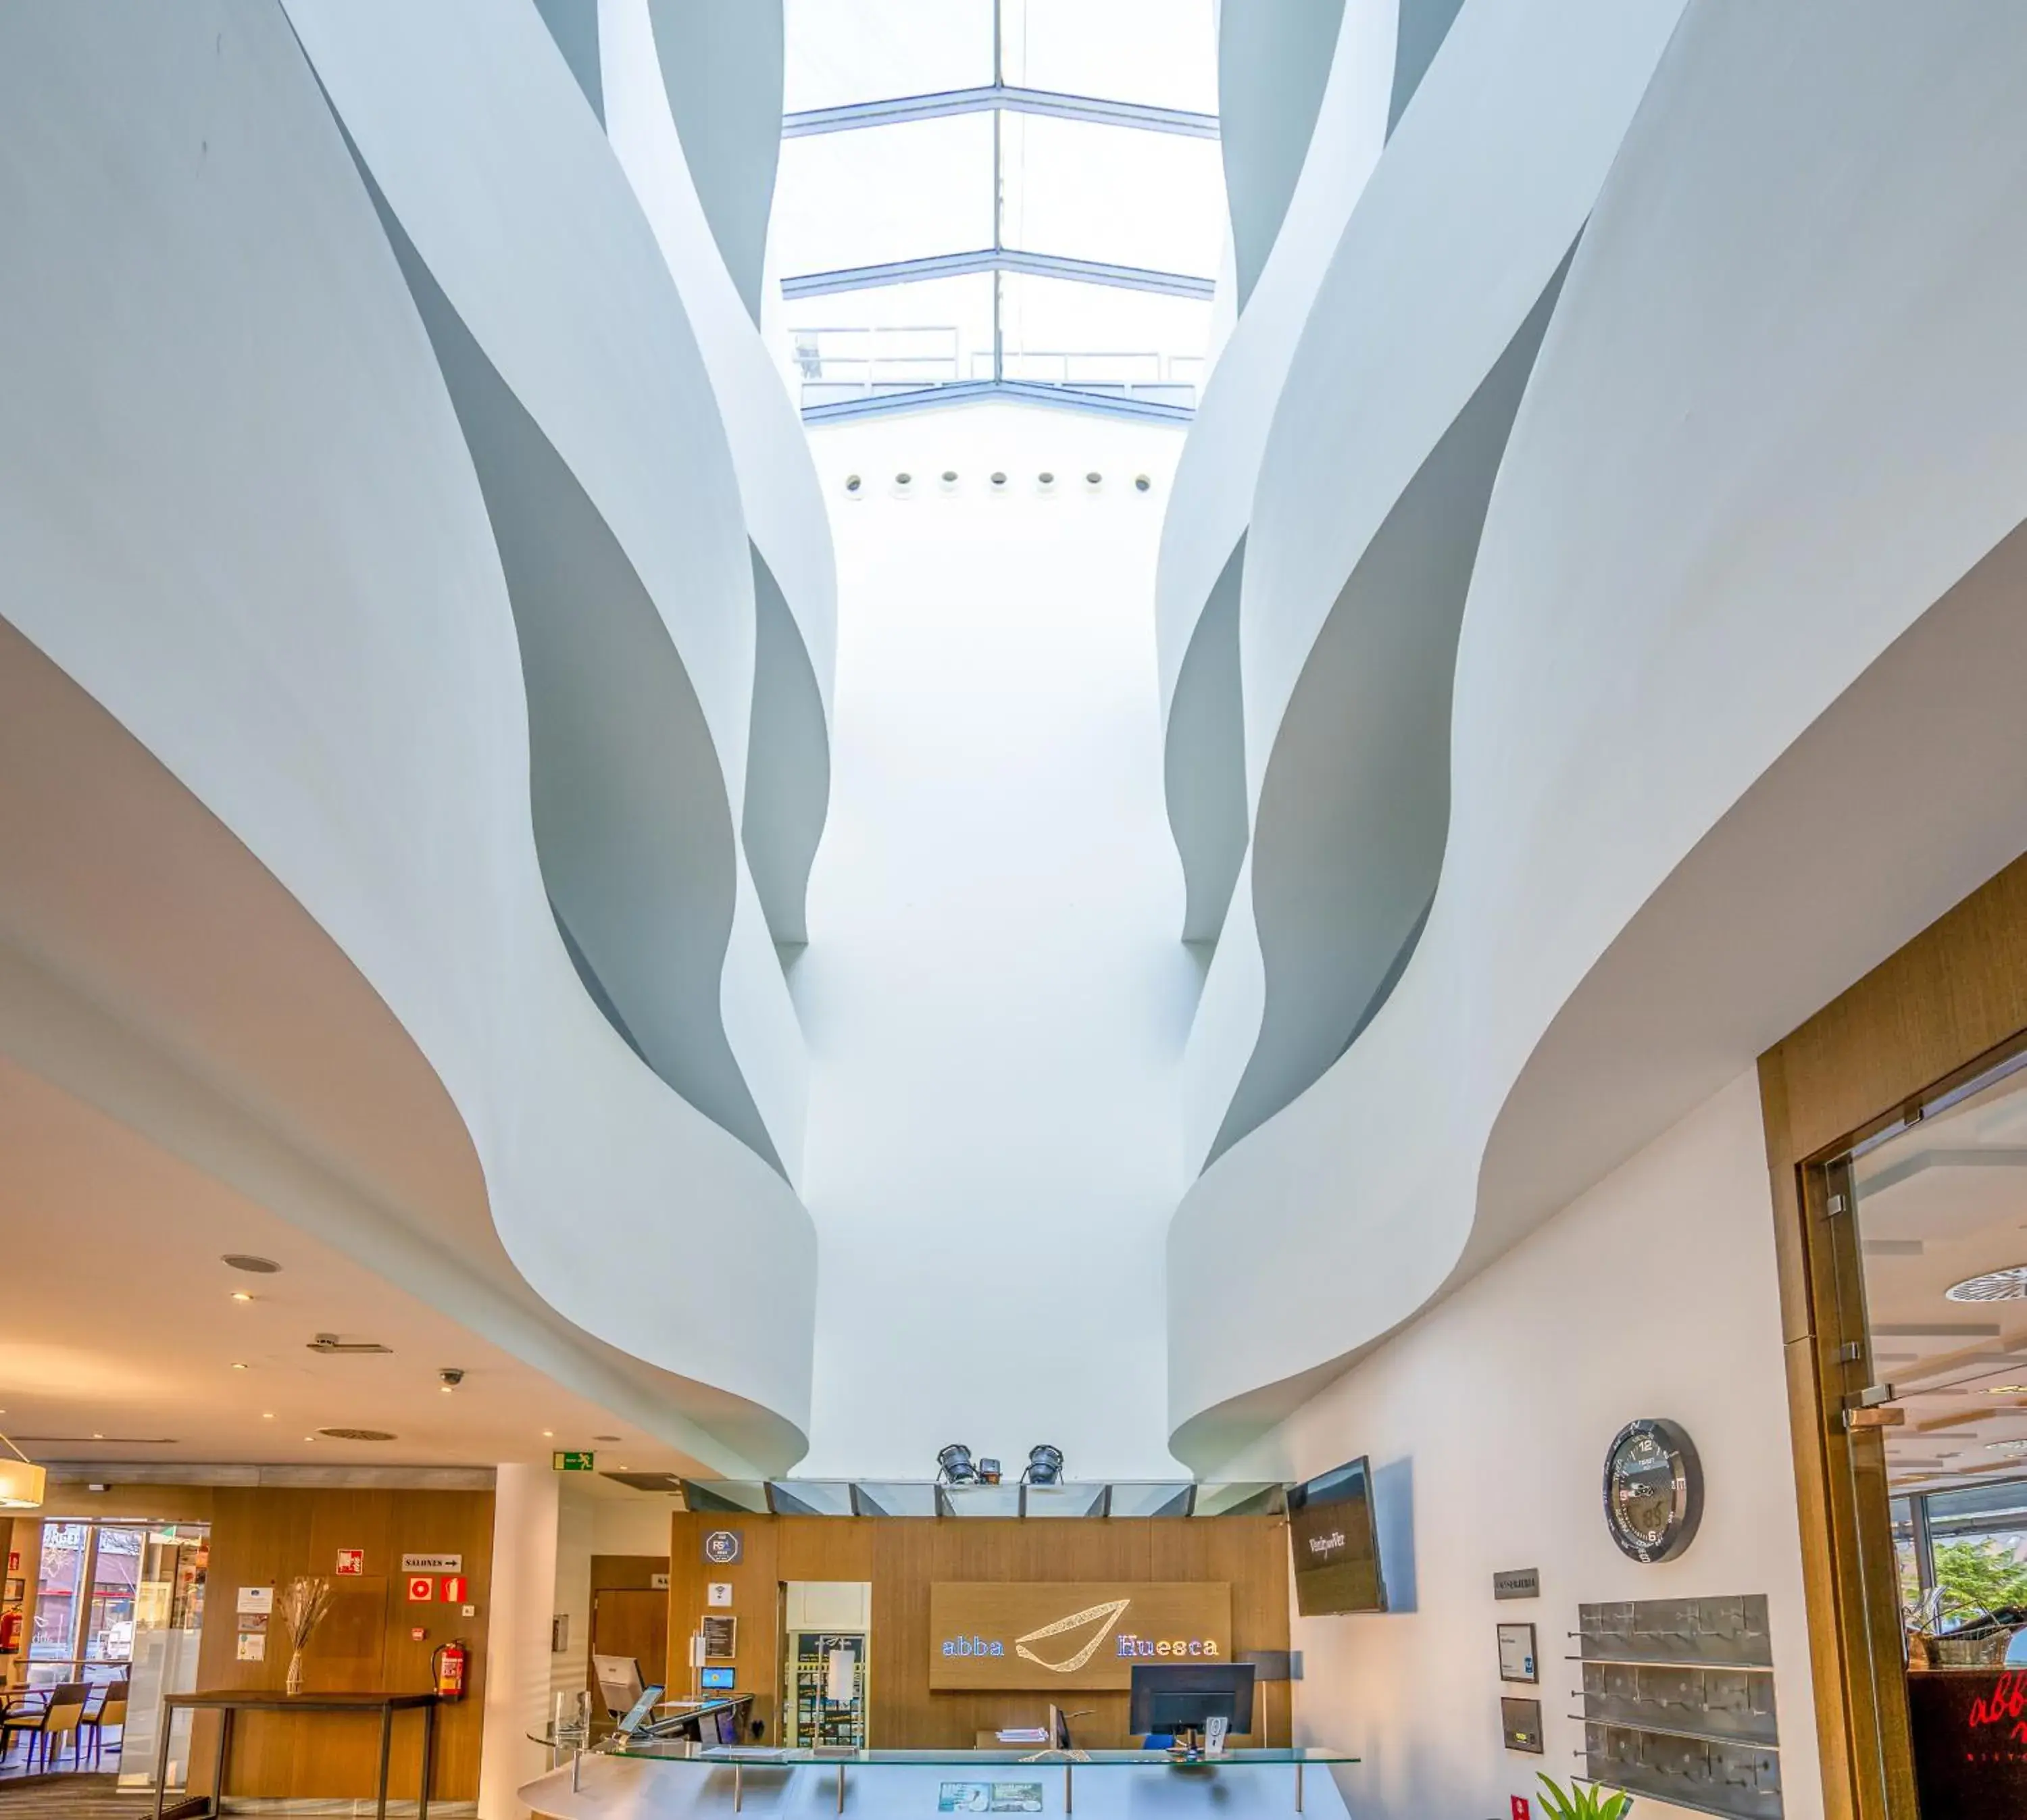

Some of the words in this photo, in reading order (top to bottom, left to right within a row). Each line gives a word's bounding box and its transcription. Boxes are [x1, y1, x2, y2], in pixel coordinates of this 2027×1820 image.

[1639, 1440, 1653, 1452] 12
[1647, 1530, 1657, 1541] 6
[943, 1636, 1005, 1657] abba
[1117, 1634, 1219, 1657] Huesca
